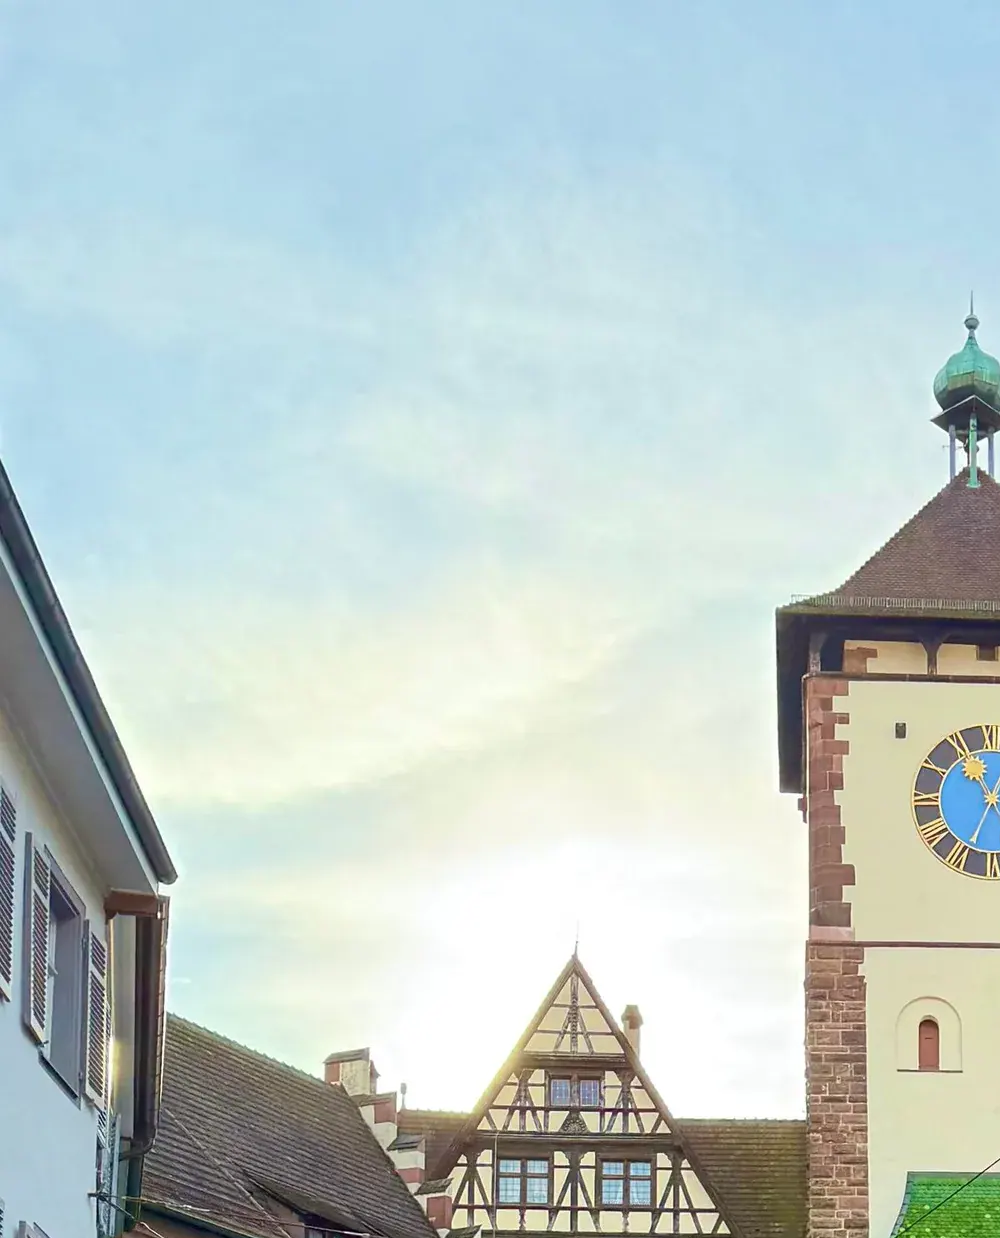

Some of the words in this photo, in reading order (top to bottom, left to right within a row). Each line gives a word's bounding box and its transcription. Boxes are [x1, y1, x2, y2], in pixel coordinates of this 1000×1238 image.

[922, 757, 947, 777] X
[920, 817, 950, 848] VIII
[946, 841, 970, 872] VII
